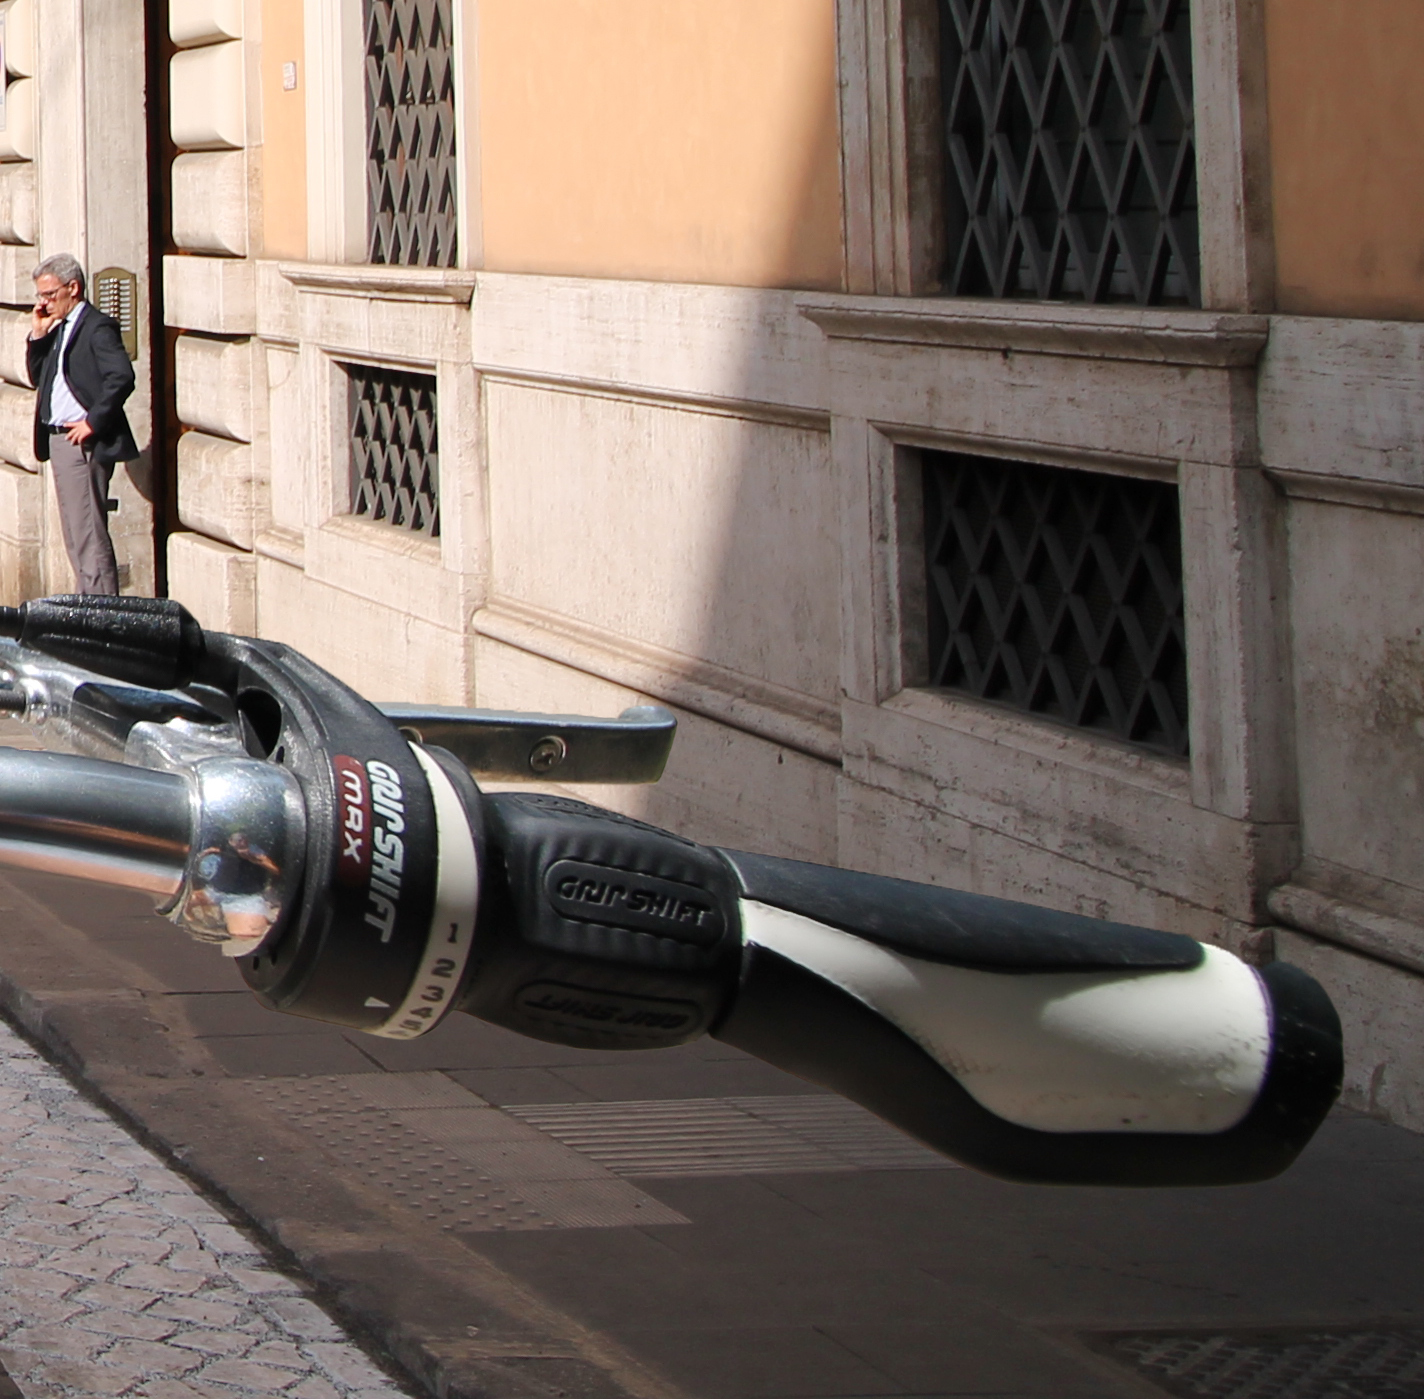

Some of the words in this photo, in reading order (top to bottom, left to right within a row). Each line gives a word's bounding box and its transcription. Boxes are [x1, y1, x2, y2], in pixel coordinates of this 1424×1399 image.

[448, 922, 458, 944] 1
[431, 958, 456, 978] 2
[420, 985, 445, 1002] 3
[410, 1007, 433, 1019] 4
